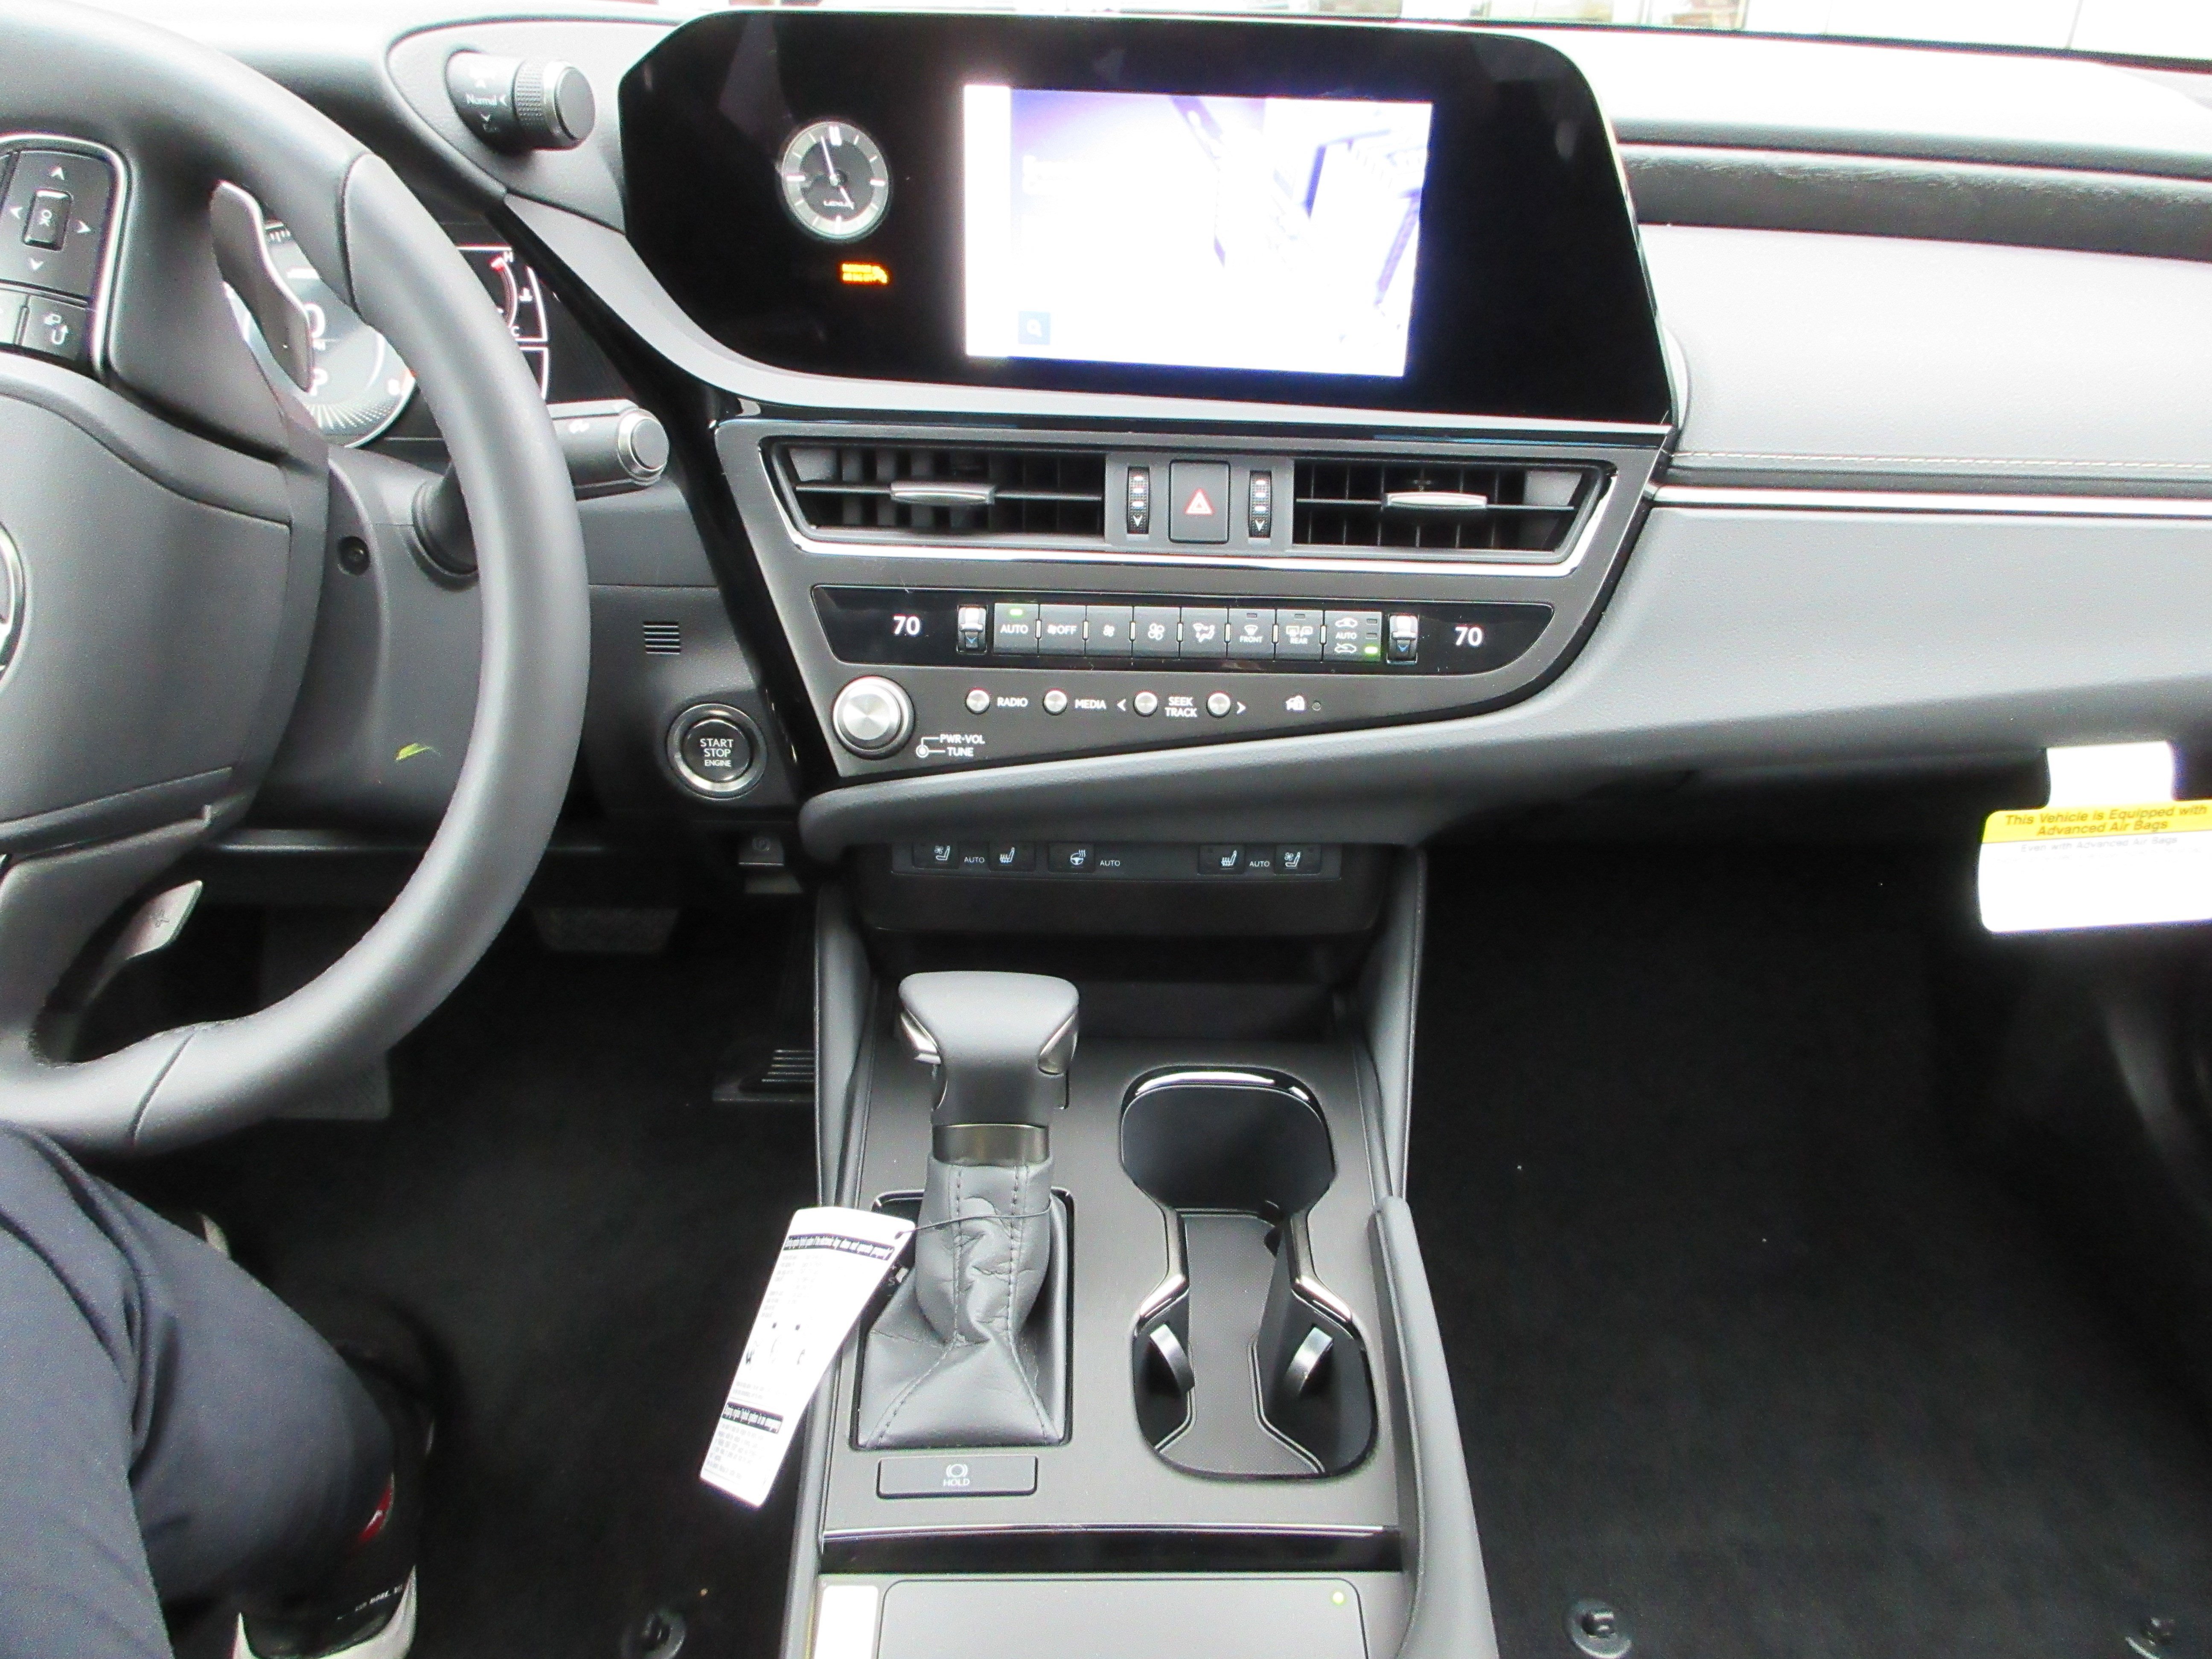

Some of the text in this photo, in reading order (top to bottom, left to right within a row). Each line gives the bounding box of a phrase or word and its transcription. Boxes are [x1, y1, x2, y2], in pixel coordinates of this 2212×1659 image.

[894, 616, 921, 635] 70
[1000, 624, 1028, 634] AUTO
[1059, 625, 1077, 634] OFF
[1455, 626, 1482, 646] 70
[997, 697, 1028, 707] RADIO
[1074, 699, 1107, 710] MEDIA
[1168, 696, 1193, 707] SEEK
[1165, 707, 1197, 718] TRACK
[700, 738, 734, 748] START
[704, 748, 731, 757] STOP
[947, 747, 974, 757] TUNE
[2006, 805, 2207, 825] This Vehicle is Equipped with
[2036, 820, 2168, 836] Advanced Air Bags
[2021, 844, 2046, 852] Even
[2051, 842, 2072, 850] with
[2077, 838, 2129, 849] Advanced
[2151, 837, 2177, 846] Bags
[943, 1478, 970, 1487] HOLD
